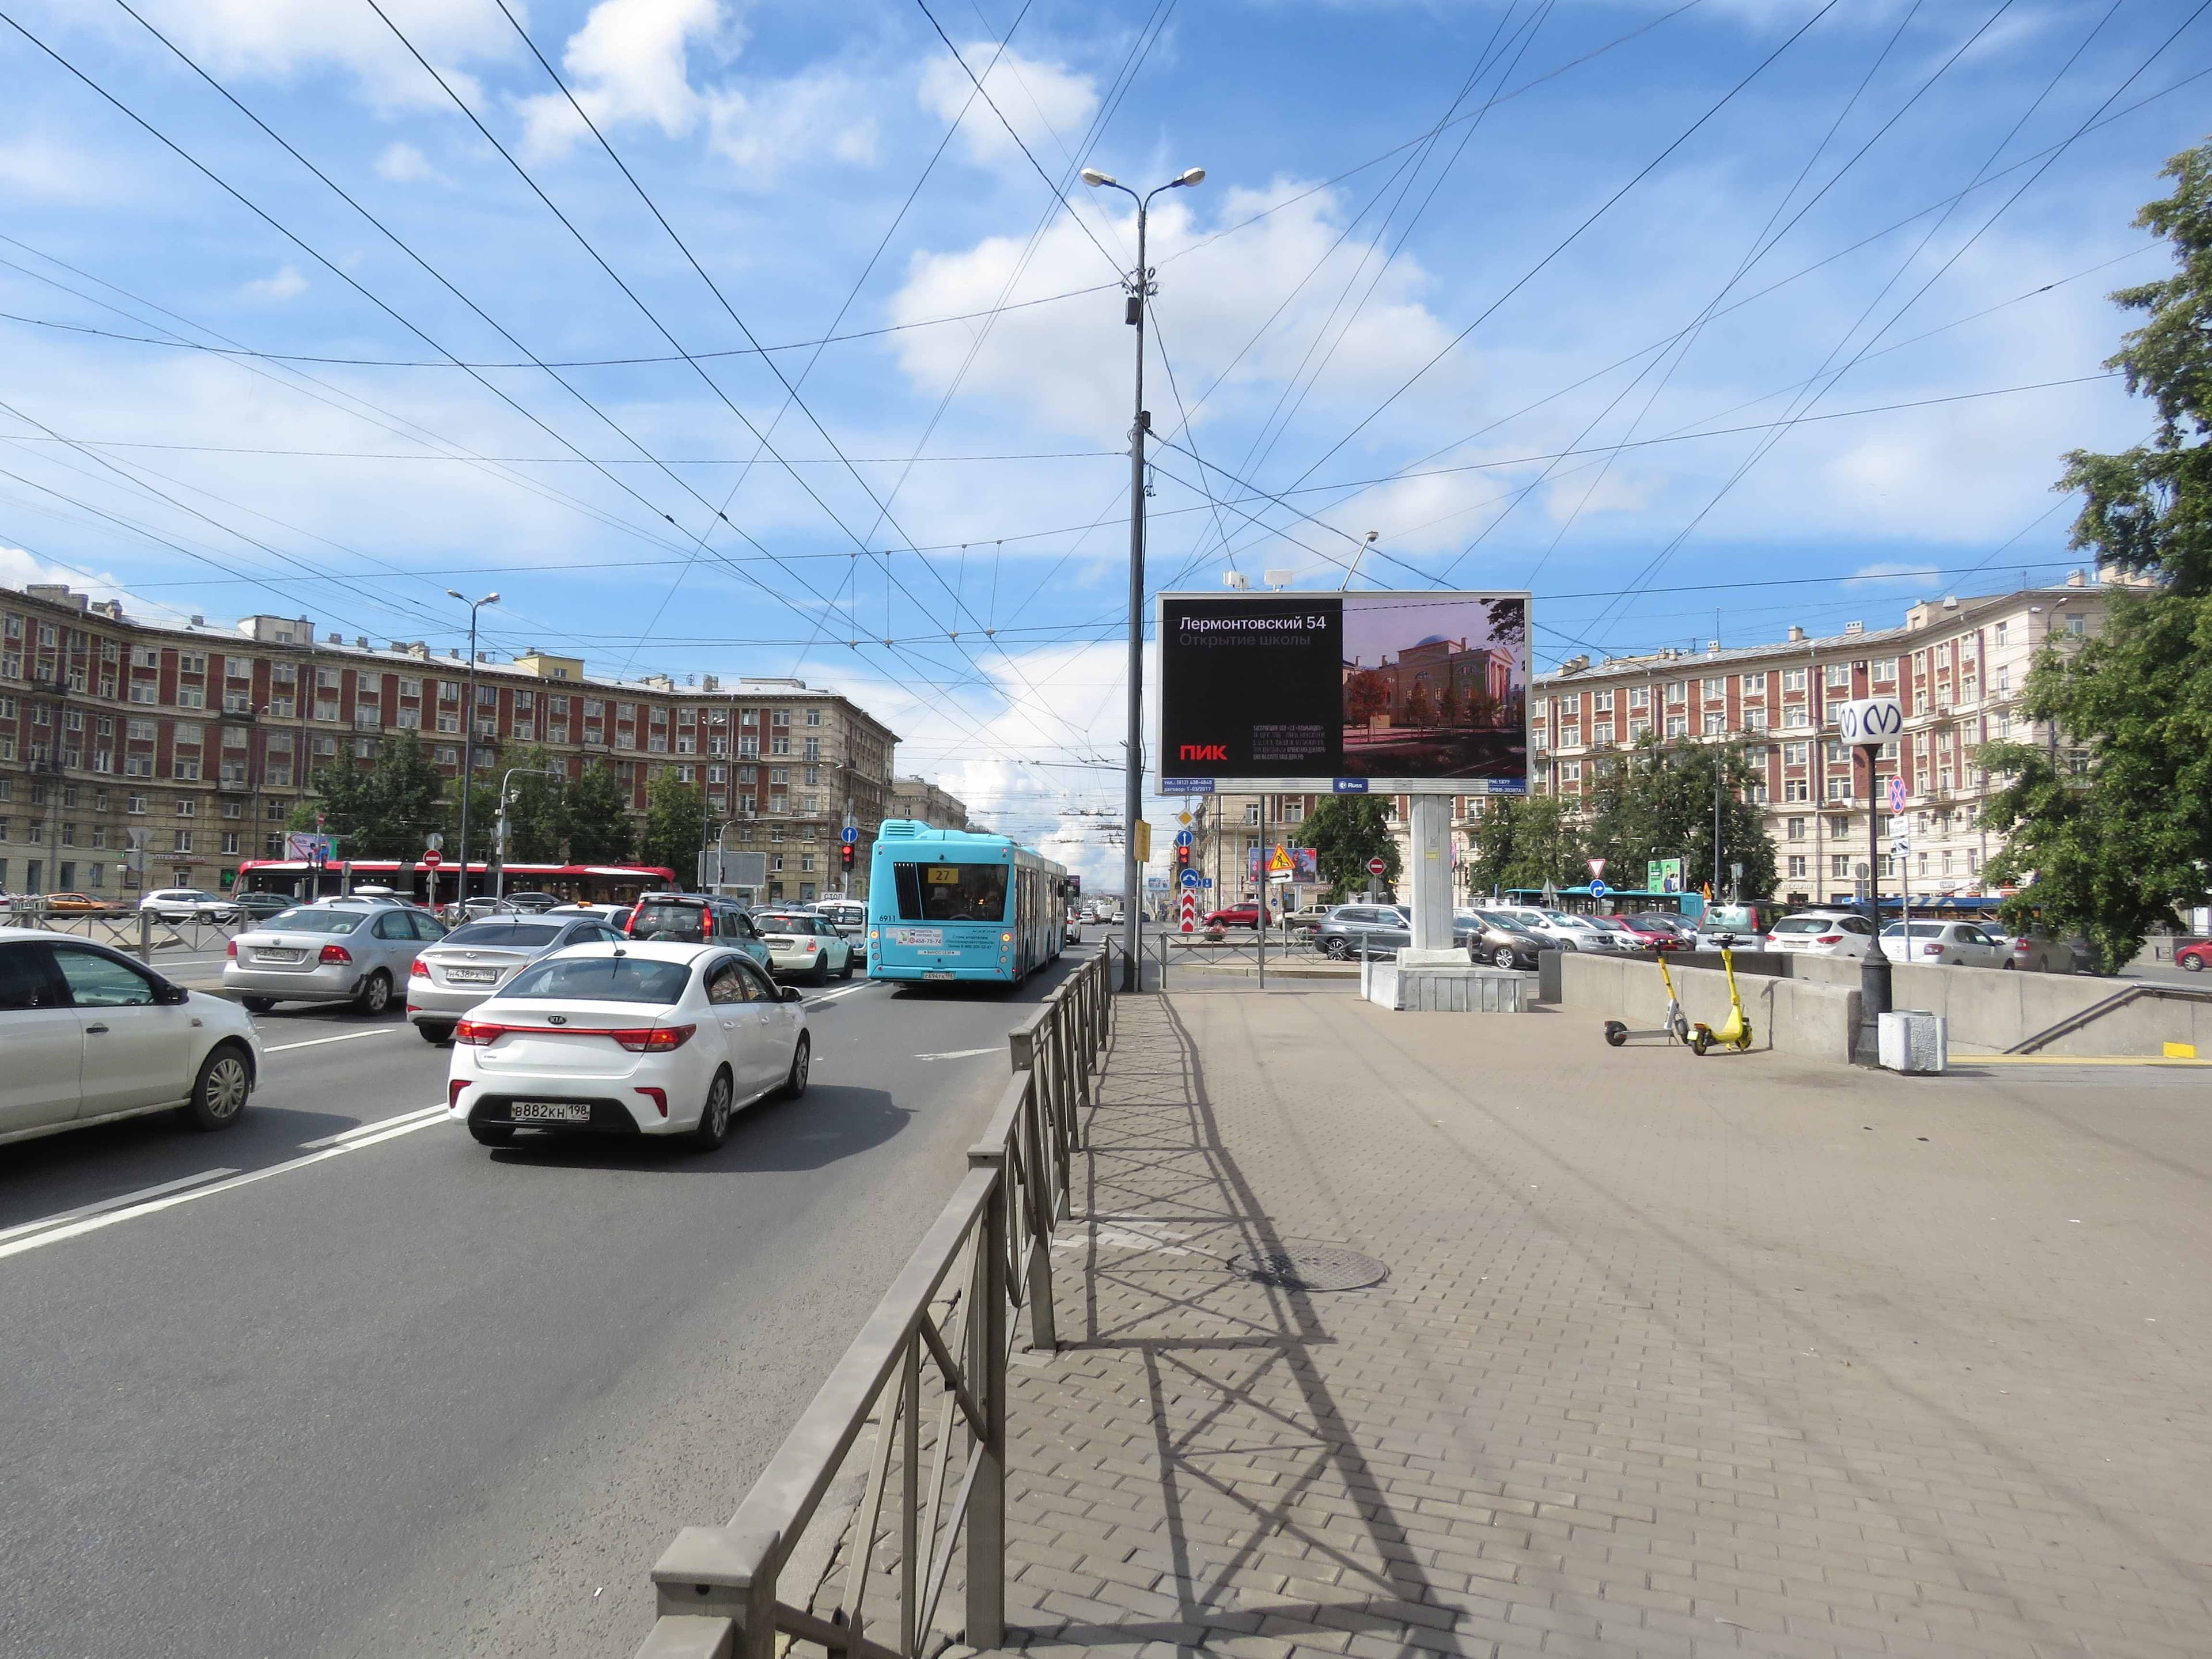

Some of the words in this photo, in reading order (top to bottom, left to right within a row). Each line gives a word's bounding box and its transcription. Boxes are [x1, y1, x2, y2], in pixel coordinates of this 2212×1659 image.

[1179, 616, 1302, 632] Лермонтовский
[1306, 616, 1327, 629] 54
[1180, 633, 1256, 649] Открытие
[1259, 635, 1311, 646] школы
[1180, 745, 1228, 760] ПИК
[935, 870, 950, 881] 27
[449, 969, 480, 978] Н438РХ
[516, 1104, 565, 1118] В882КН
[569, 1105, 587, 1115] 198
